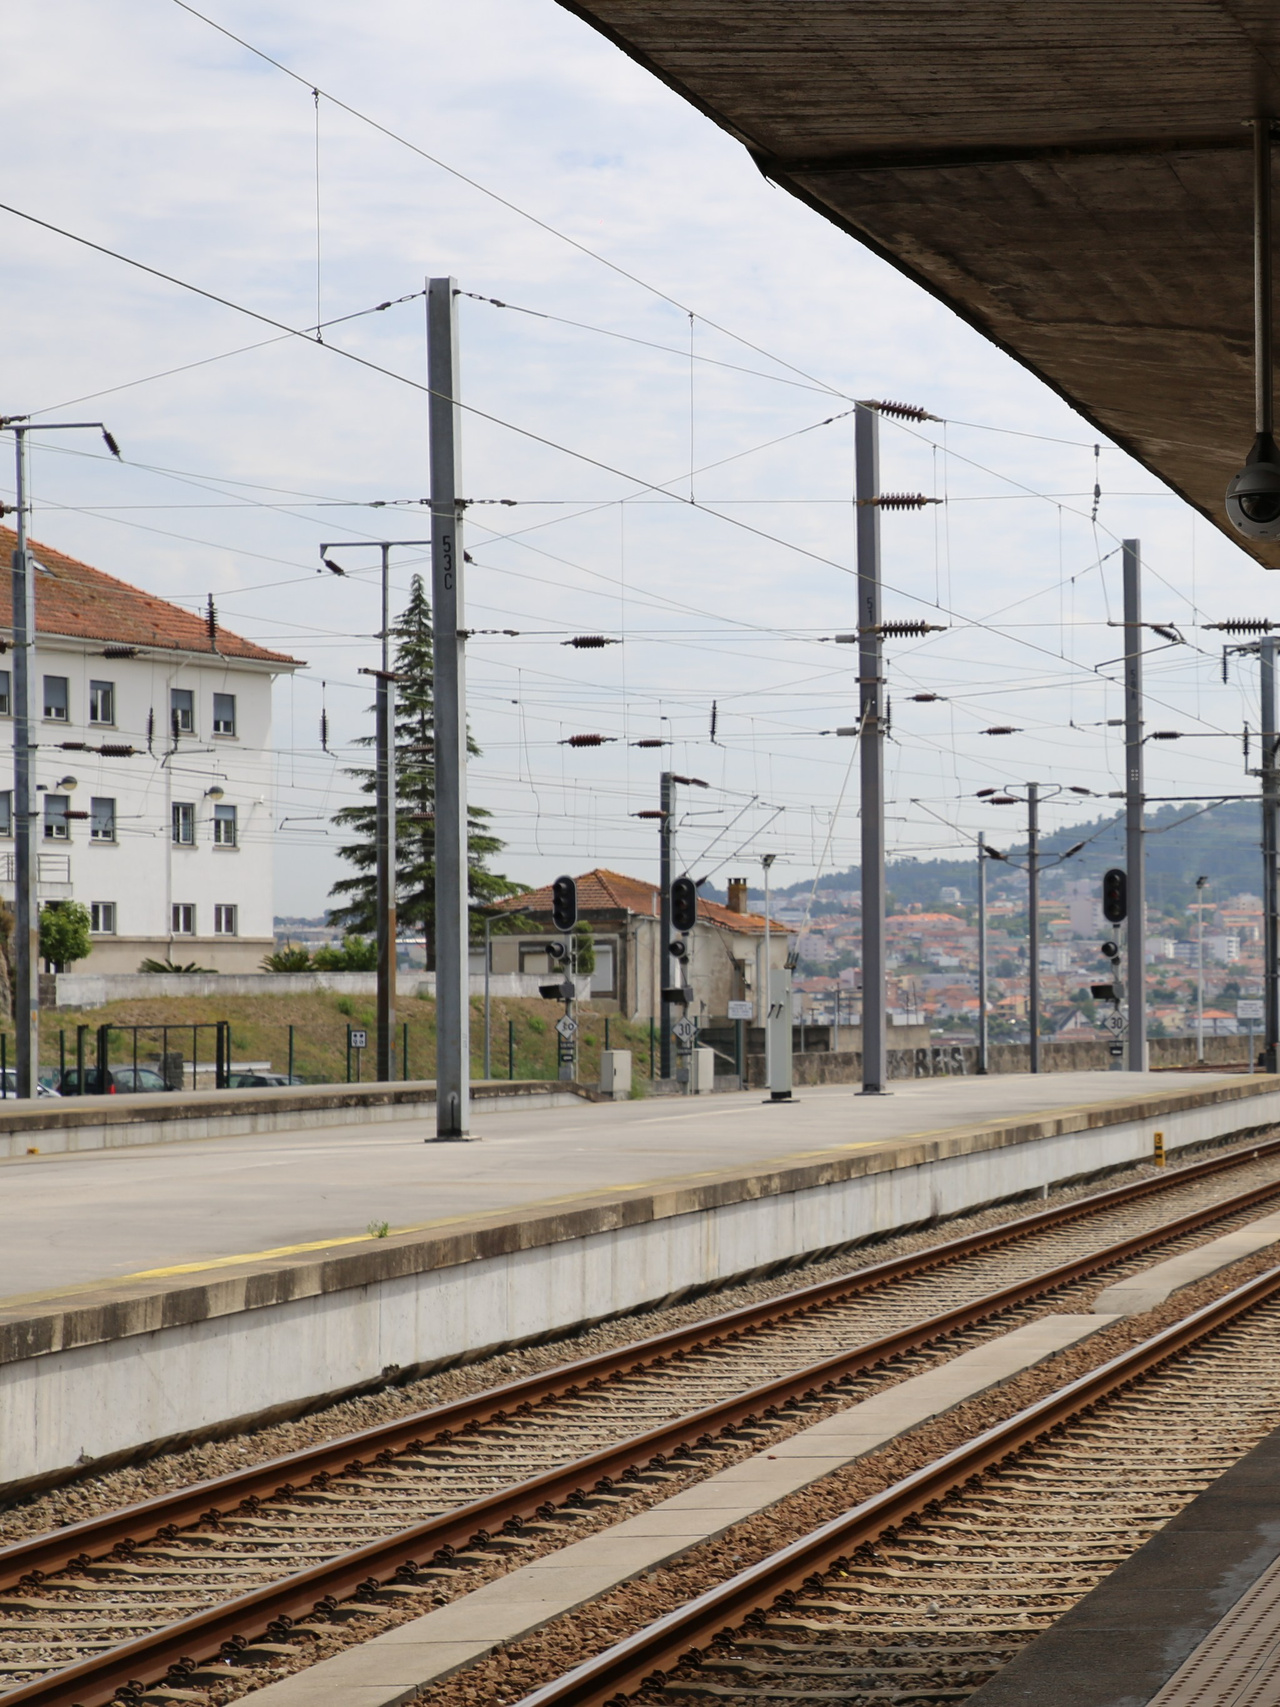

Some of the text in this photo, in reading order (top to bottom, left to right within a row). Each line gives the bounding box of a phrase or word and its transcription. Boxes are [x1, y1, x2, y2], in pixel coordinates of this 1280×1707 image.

[442, 535, 453, 590] 53C
[866, 596, 873, 622] 51
[678, 1023, 691, 1036] 30
[1110, 1017, 1122, 1029] 30
